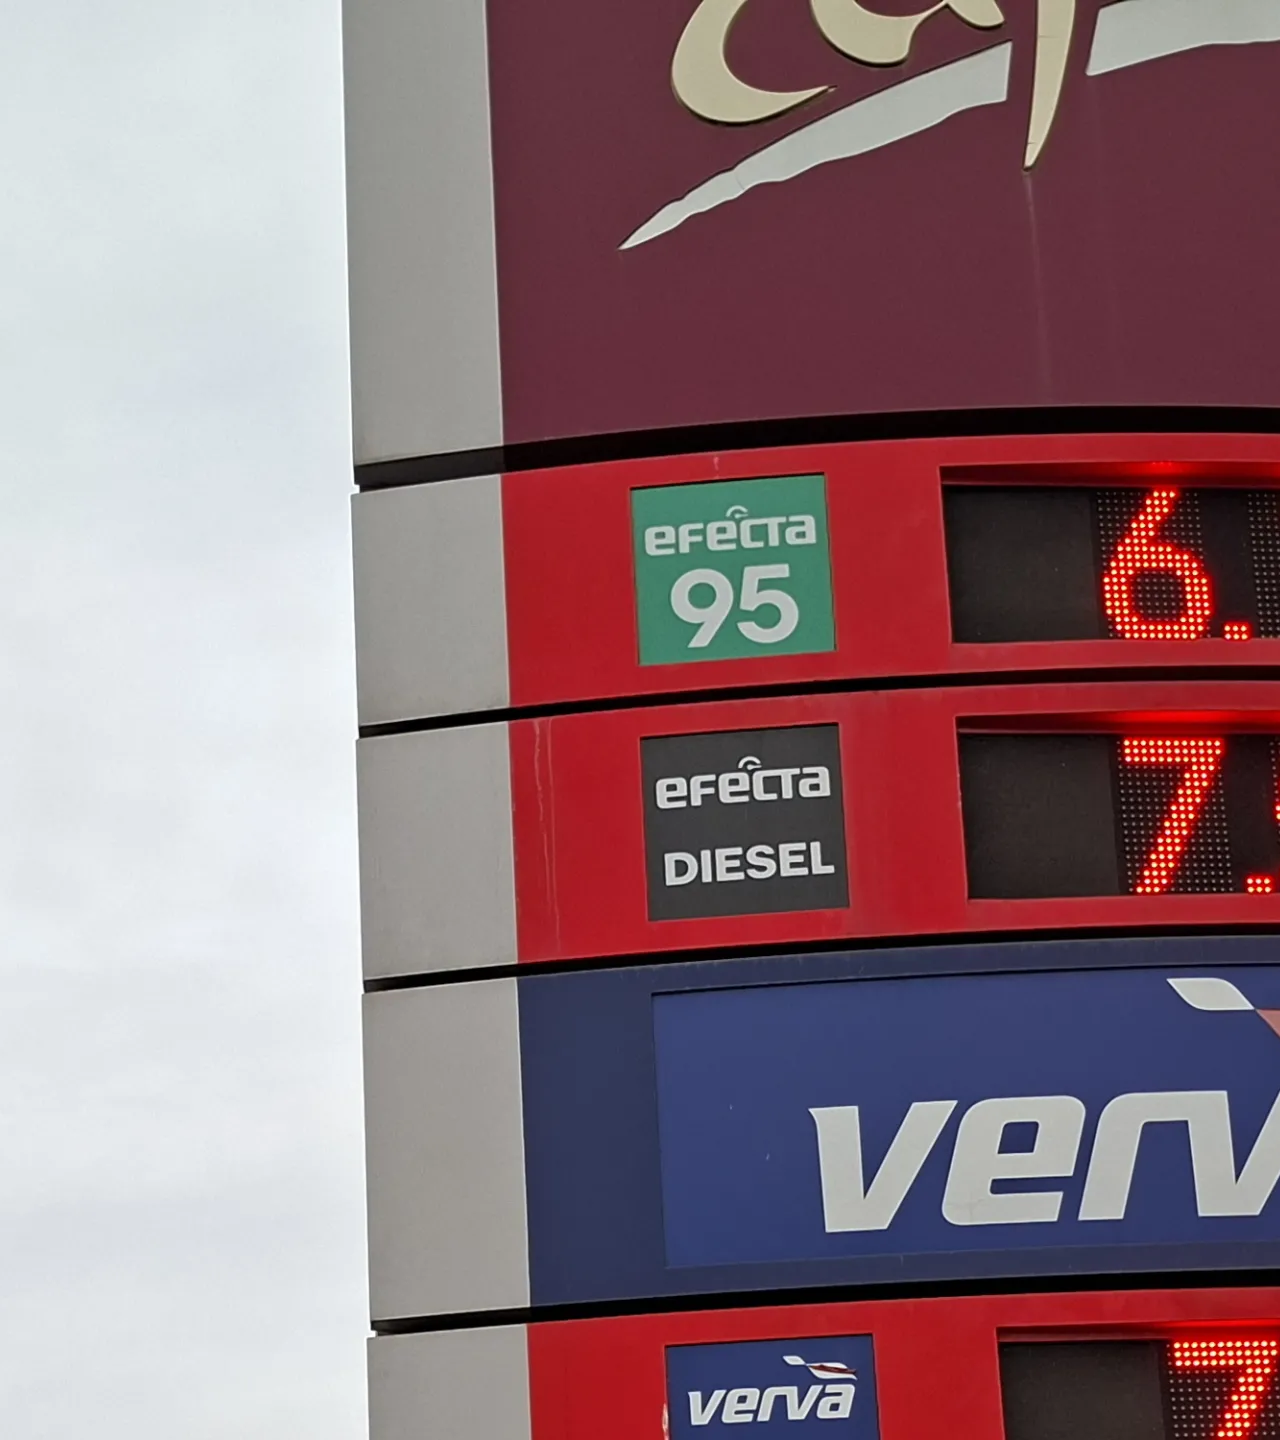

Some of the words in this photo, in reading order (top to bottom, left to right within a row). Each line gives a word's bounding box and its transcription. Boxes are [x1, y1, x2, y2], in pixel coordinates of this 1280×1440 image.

[670, 563, 800, 649] 95
[664, 841, 835, 887] DIESEL
[687, 1372, 856, 1426] verva
